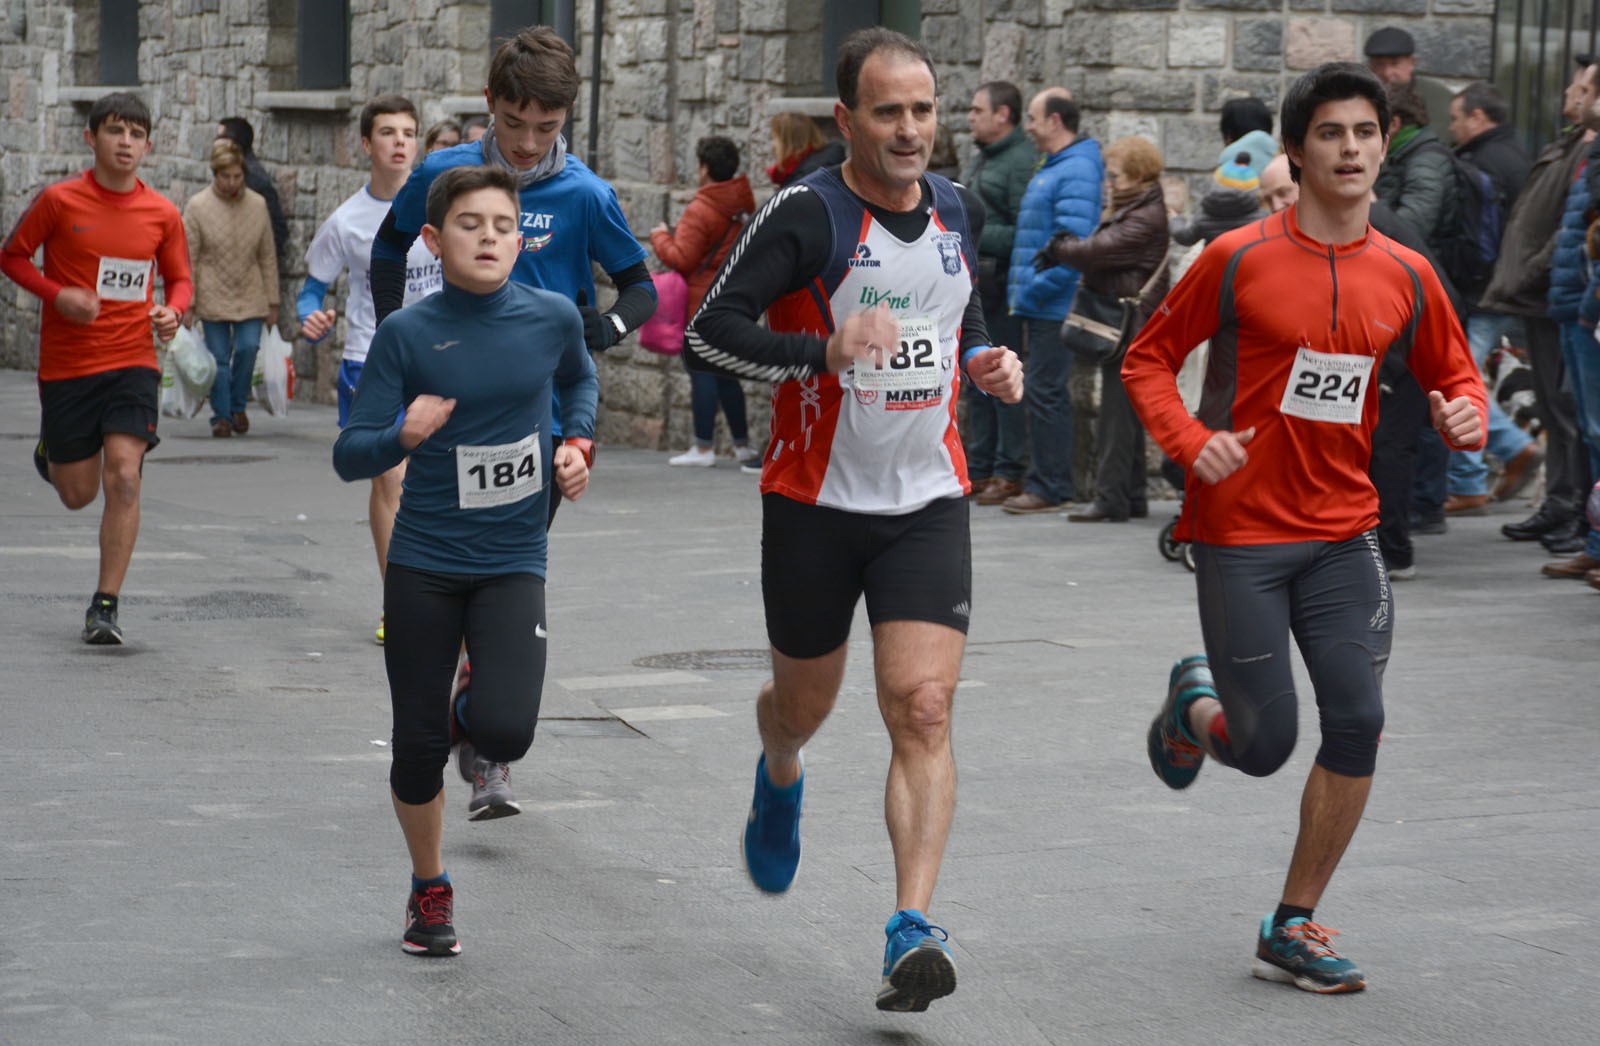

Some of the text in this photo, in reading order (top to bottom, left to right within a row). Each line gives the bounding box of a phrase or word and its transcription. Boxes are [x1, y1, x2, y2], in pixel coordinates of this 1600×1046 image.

[849, 259, 881, 268] VIATOR
[102, 270, 145, 288] 294
[1294, 370, 1361, 403] 224
[468, 452, 535, 490] 184
